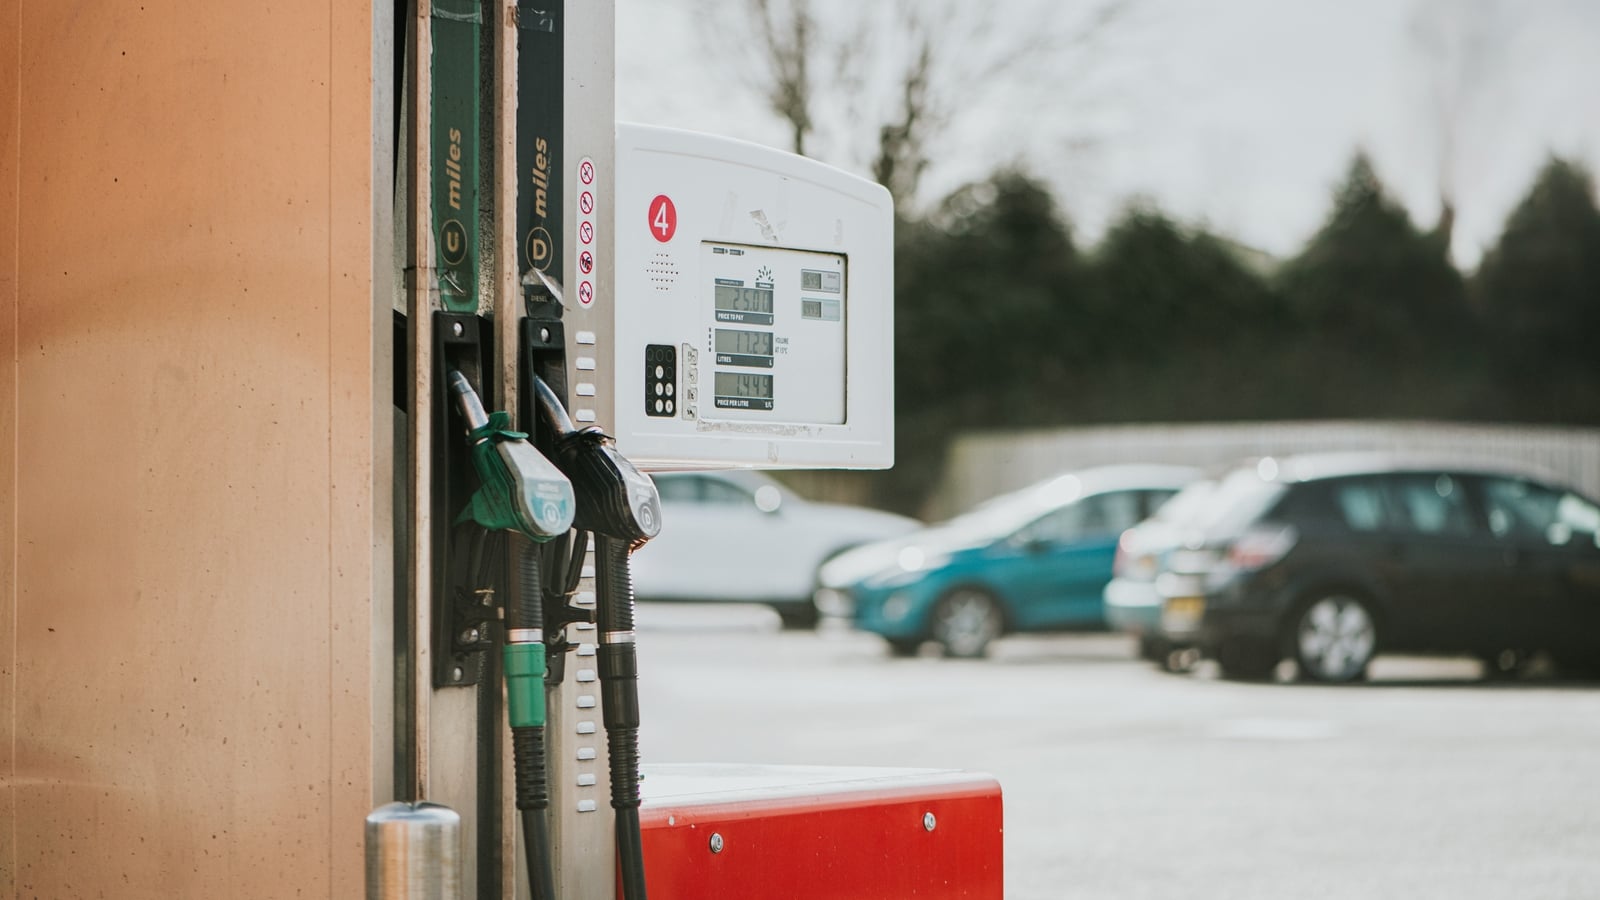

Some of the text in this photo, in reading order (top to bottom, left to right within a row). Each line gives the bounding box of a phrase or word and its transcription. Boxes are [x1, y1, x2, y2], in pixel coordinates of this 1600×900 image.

[446, 127, 461, 210] miles
[532, 137, 547, 218] miles
[654, 202, 668, 236] 4
[447, 231, 459, 252] U
[533, 239, 547, 260] D
[717, 355, 732, 363] LITRES
